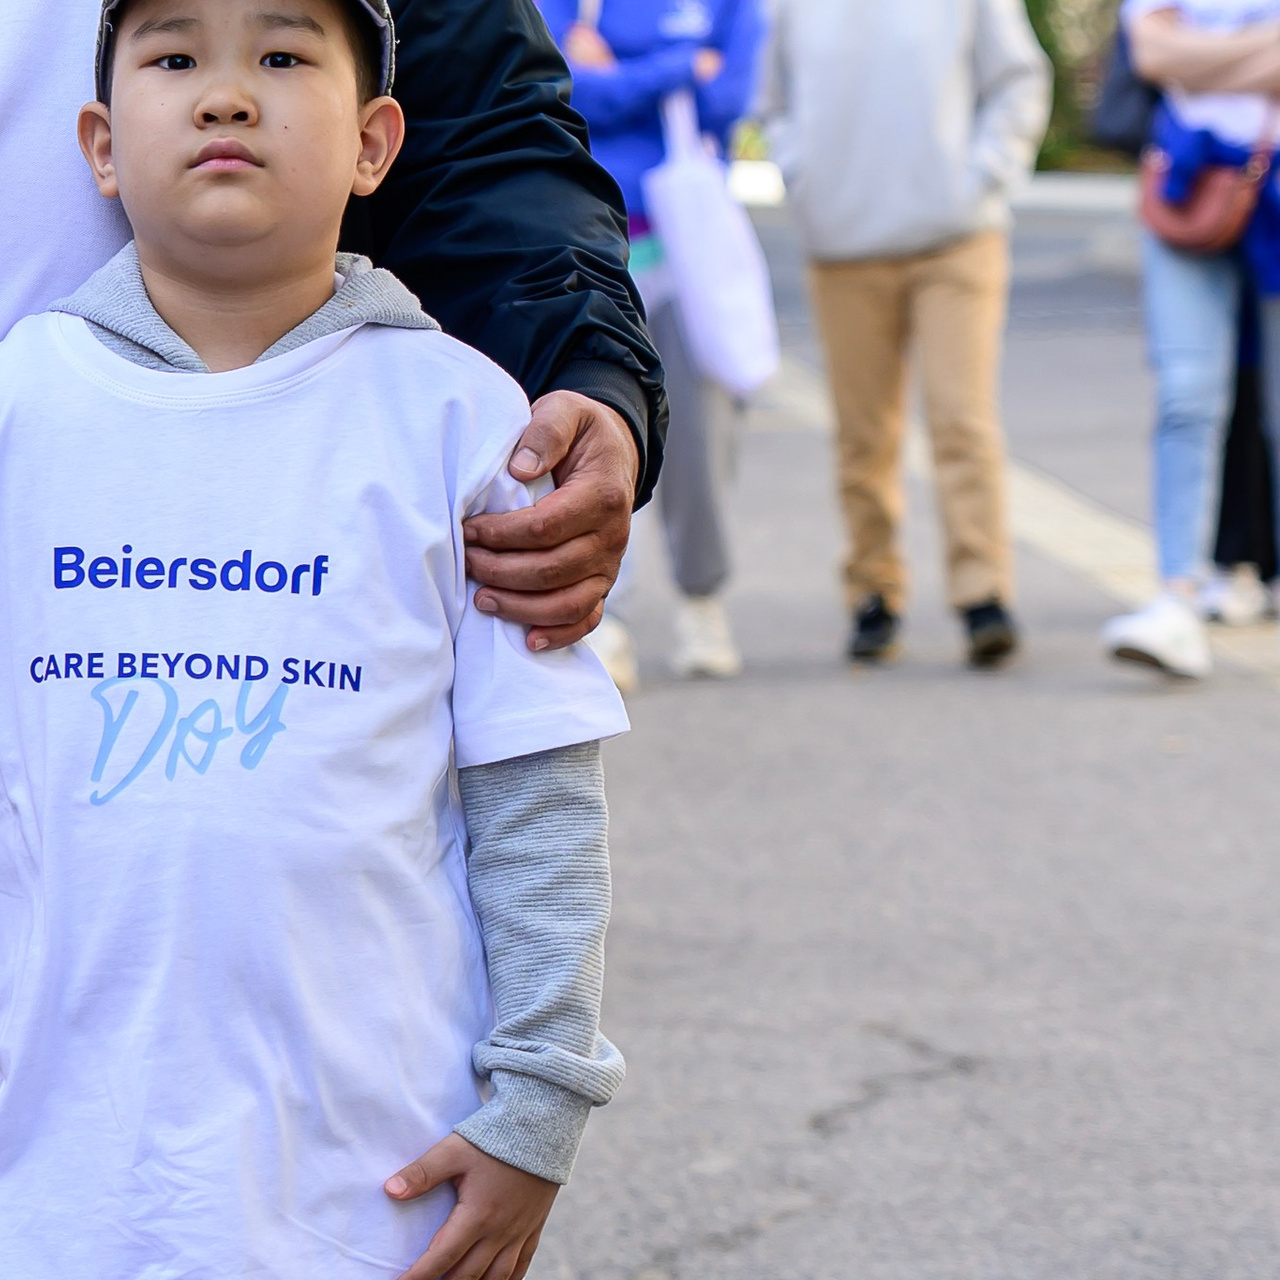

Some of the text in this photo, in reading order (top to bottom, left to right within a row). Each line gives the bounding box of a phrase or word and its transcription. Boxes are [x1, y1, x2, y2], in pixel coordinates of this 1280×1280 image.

[53, 544, 329, 596] Beiersdorf
[29, 652, 362, 692] CARE BEYOND SKIN
